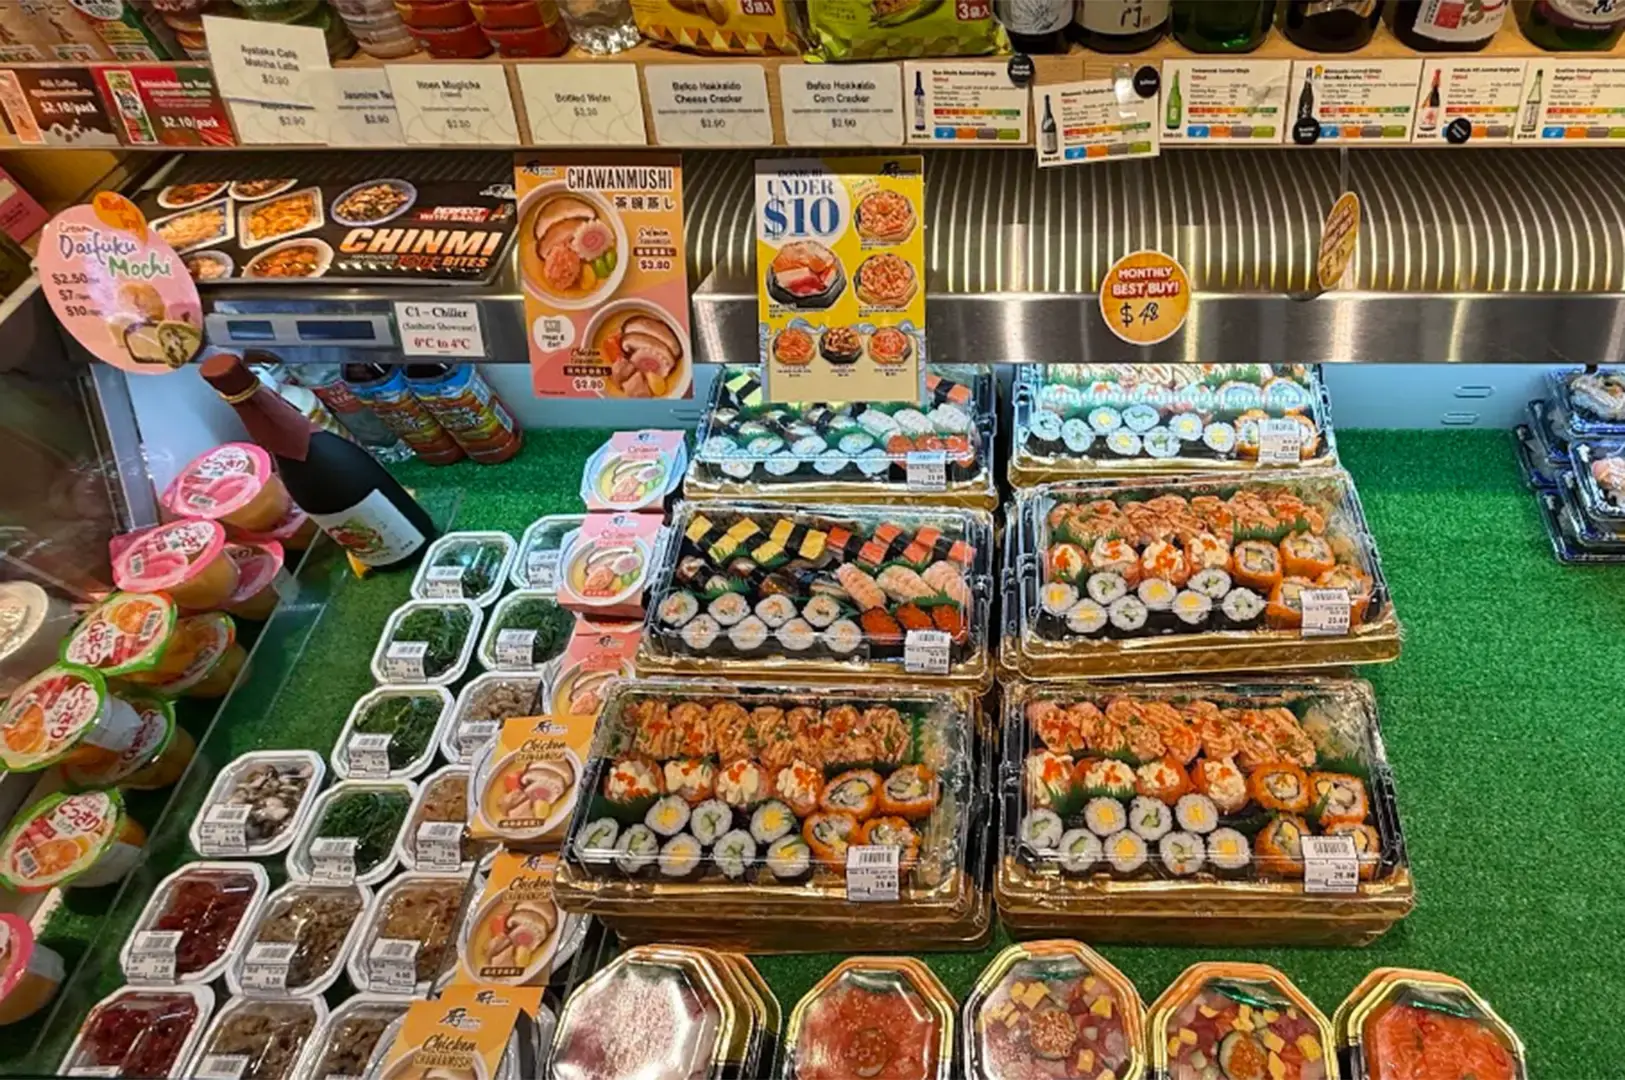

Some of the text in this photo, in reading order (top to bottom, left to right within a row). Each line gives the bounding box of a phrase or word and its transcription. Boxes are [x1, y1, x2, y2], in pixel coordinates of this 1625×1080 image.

[567, 167, 673, 190] CHAWANMUSHI
[766, 179, 835, 196] UNDER
[763, 196, 841, 241] $10
[59, 232, 137, 265] Daifuku
[339, 228, 503, 256] CHINMI
[108, 252, 171, 279] Mochi
[442, 256, 489, 267] BITES
[1118, 266, 1173, 279] MONTHLY
[1112, 280, 1179, 297] BEST BUY!
[431, 306, 468, 318] Chiller
[437, 338, 449, 349] to
[422, 1032, 478, 1051] Chicken
